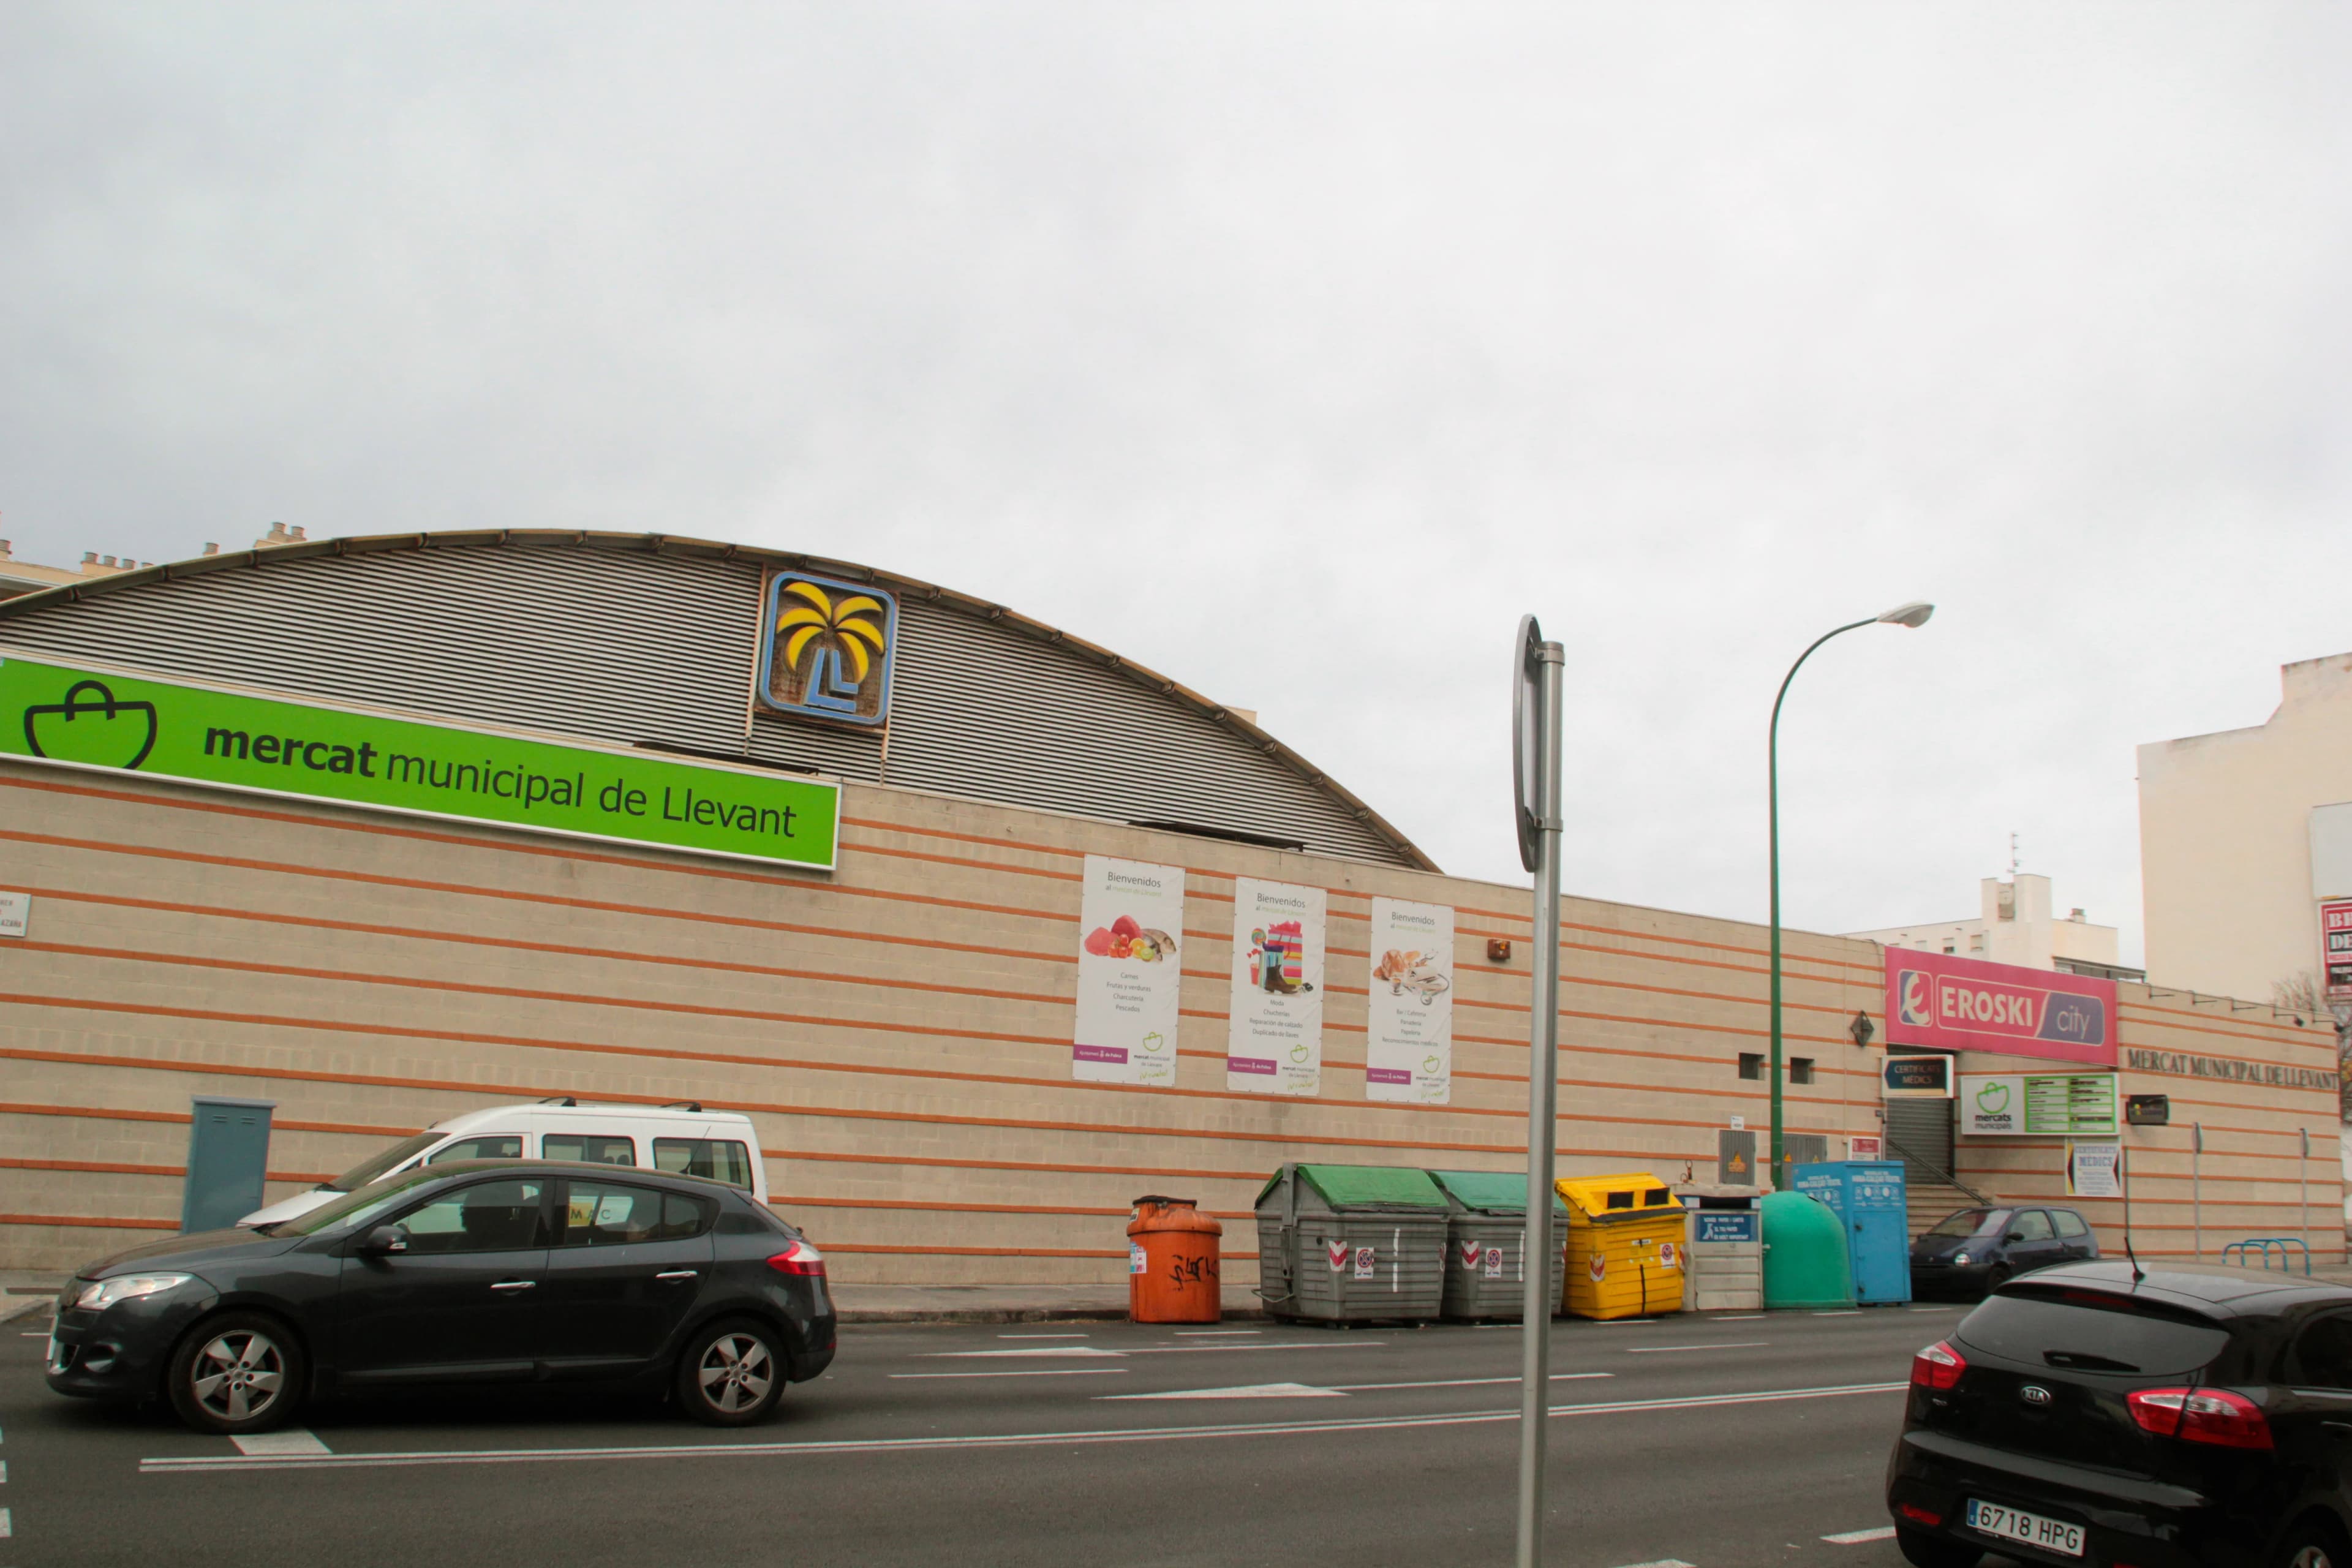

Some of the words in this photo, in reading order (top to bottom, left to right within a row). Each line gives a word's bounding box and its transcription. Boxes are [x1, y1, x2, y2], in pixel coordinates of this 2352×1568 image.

[204, 727, 377, 778] mercat
[386, 753, 584, 809] municipal
[599, 778, 647, 816] de
[663, 786, 797, 837] Llevant
[1107, 871, 1161, 888] Bienvenidos
[1257, 893, 1305, 908] Bienvenidos
[1392, 911, 1435, 925] Bienvenidos
[1107, 981, 1123, 990] Frutas
[1115, 1004, 1140, 1012] Pescados
[1941, 986, 2033, 1027] EROSKI
[2057, 1005, 2090, 1039] city
[1253, 1028, 1277, 1037] Duplicado
[2128, 1048, 2187, 1072] MERCAT
[2190, 1055, 2264, 1082] MUNICIPAL
[2264, 1065, 2283, 1084] DE
[2283, 1067, 2339, 1090] LLEVANT
[2025, 1389, 2046, 1402] KIA
[1980, 1506, 2031, 1536] 6718
[2038, 1520, 2078, 1550] HPG
